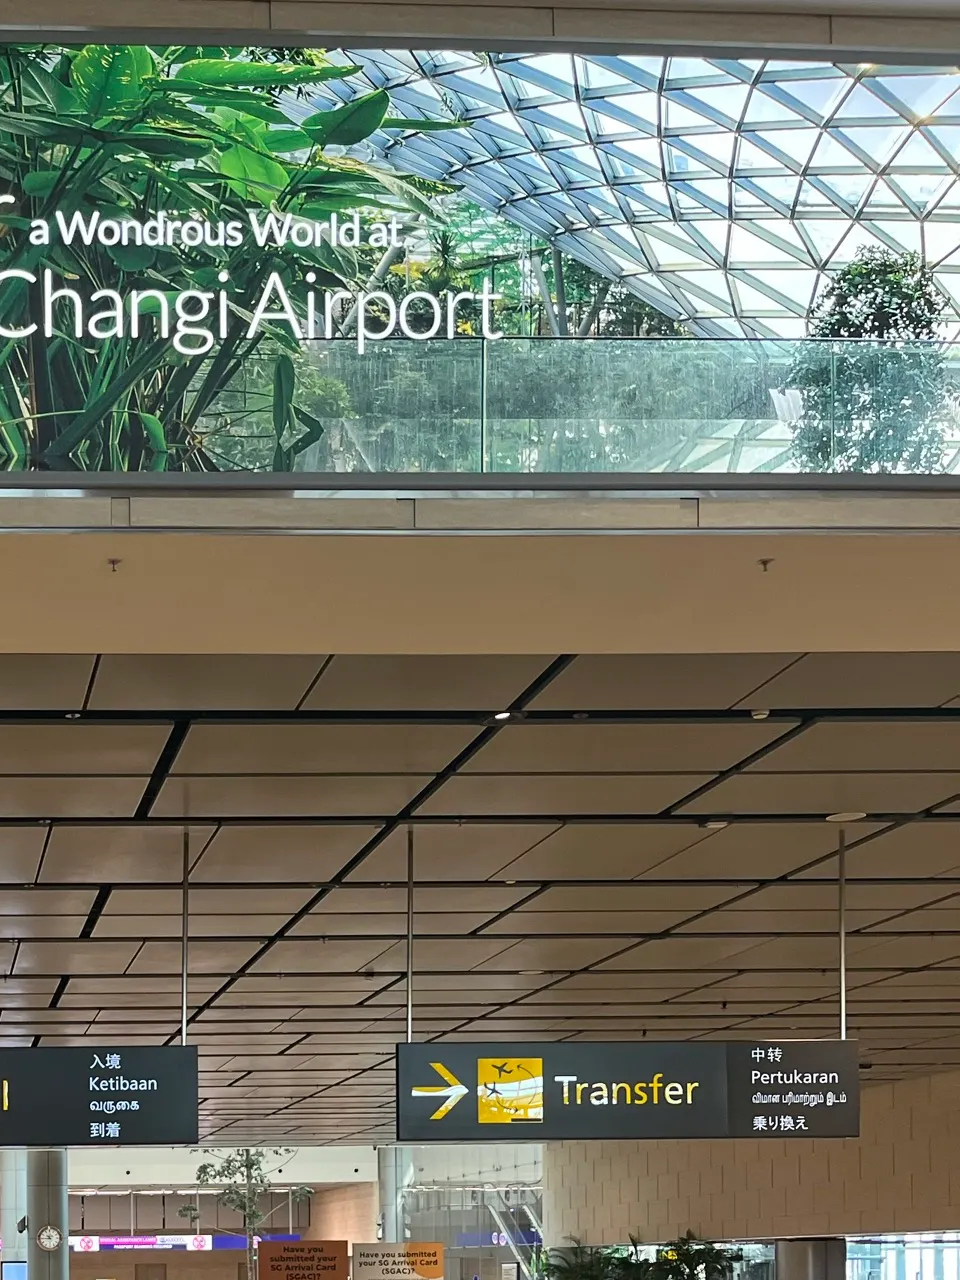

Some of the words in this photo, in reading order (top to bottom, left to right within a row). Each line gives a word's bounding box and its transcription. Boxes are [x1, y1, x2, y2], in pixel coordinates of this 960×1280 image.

[28, 218, 50, 246] a
[56, 210, 242, 247] Wondrous
[251, 212, 361, 248] World
[368, 217, 404, 248] at
[246, 271, 504, 355] Airport
[89, 1053, 122, 1069] 入境
[751, 1047, 783, 1062] 中转
[89, 1075, 158, 1091] Ketibaan
[751, 1069, 839, 1084] Pertukaran
[555, 1073, 700, 1107] Transfer
[89, 1100, 140, 1114] வருகை
[89, 1121, 121, 1138] 到着
[752, 1115, 809, 1131] 乗り換え
[269, 1255, 315, 1263] submitted
[284, 1263, 313, 1271] Arrival
[316, 1263, 336, 1271] Card
[286, 1273, 321, 1280] (SGAC)?
